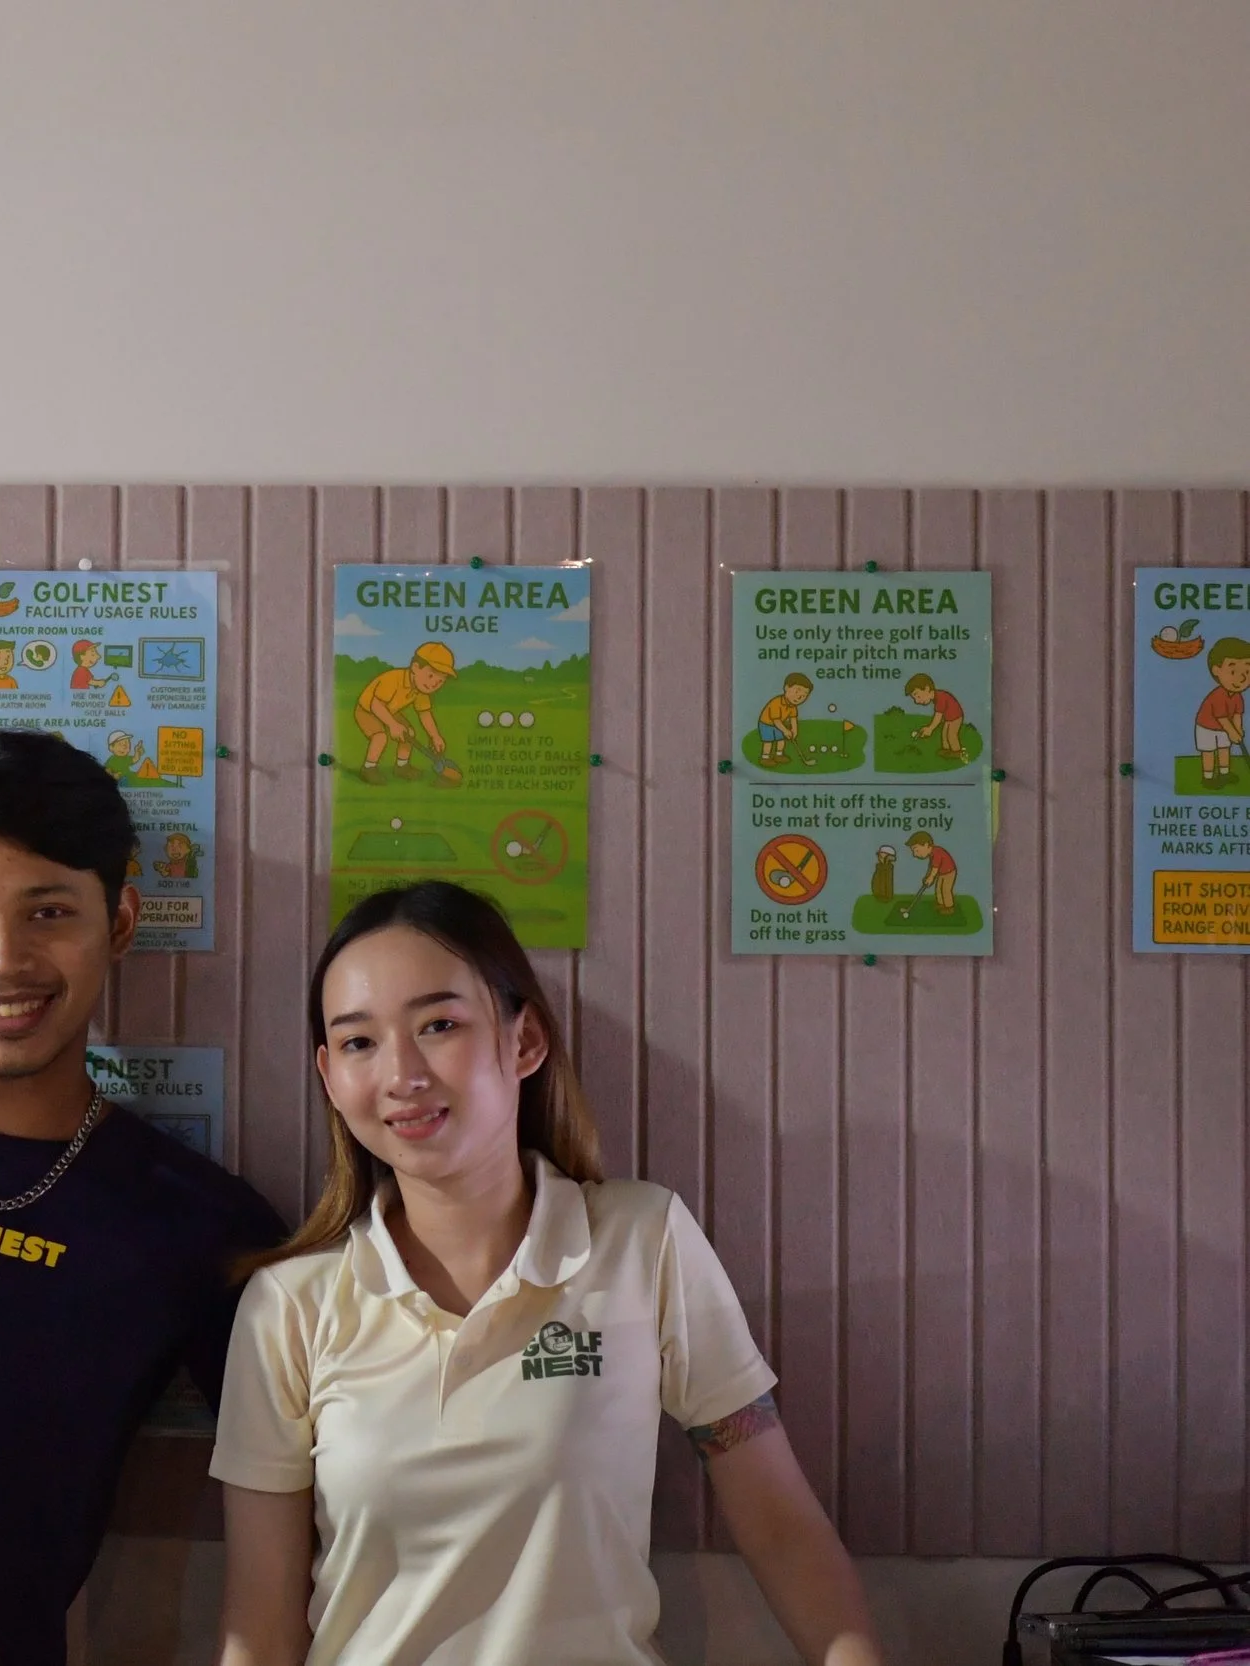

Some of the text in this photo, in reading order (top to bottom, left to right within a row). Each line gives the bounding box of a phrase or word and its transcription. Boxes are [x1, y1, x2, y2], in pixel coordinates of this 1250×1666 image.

[33, 581, 168, 603] GOLFNEST
[356, 581, 569, 609] GREEN AREA
[1154, 583, 1250, 610] GREE
[755, 588, 958, 614] GREEN AREA
[25, 606, 197, 619] FACILITY USAGE RULES
[37, 626, 68, 636] ROOM
[71, 626, 103, 636] USAGE
[425, 615, 499, 633] USAGE
[755, 625, 970, 643] Use only three golf balls
[758, 645, 957, 663] and repair pitch marks
[815, 665, 901, 680] each time
[11, 717, 41, 727] GAME
[43, 717, 70, 728] AREA
[73, 718, 107, 728] USAGE
[172, 731, 187, 740] NO
[467, 736, 554, 747] LIMIT PLAY TO
[467, 749, 581, 762] THREE GOLF BALLS
[468, 765, 581, 776] AND REPAIR DIVOTS
[467, 779, 575, 791] AFTER EACH SHOT
[752, 794, 952, 813] Do not hit off the grass.
[1153, 806, 1192, 819] LIMIT
[1198, 807, 1239, 820] GOLF
[159, 822, 198, 832] RENTAL
[752, 813, 953, 832] Use mat for driving only
[1149, 823, 1248, 838] THREE BALLS
[1161, 841, 1213, 855] MARKS
[1163, 883, 1192, 897] HIT
[167, 901, 189, 911] FOR
[1163, 902, 1206, 916] FROM
[751, 909, 828, 924] Do not hit
[1163, 920, 1215, 934] RANGE
[750, 926, 846, 944] off the grass
[99, 1082, 203, 1096] USAGE RULES
[521, 1354, 603, 1381] NEST
